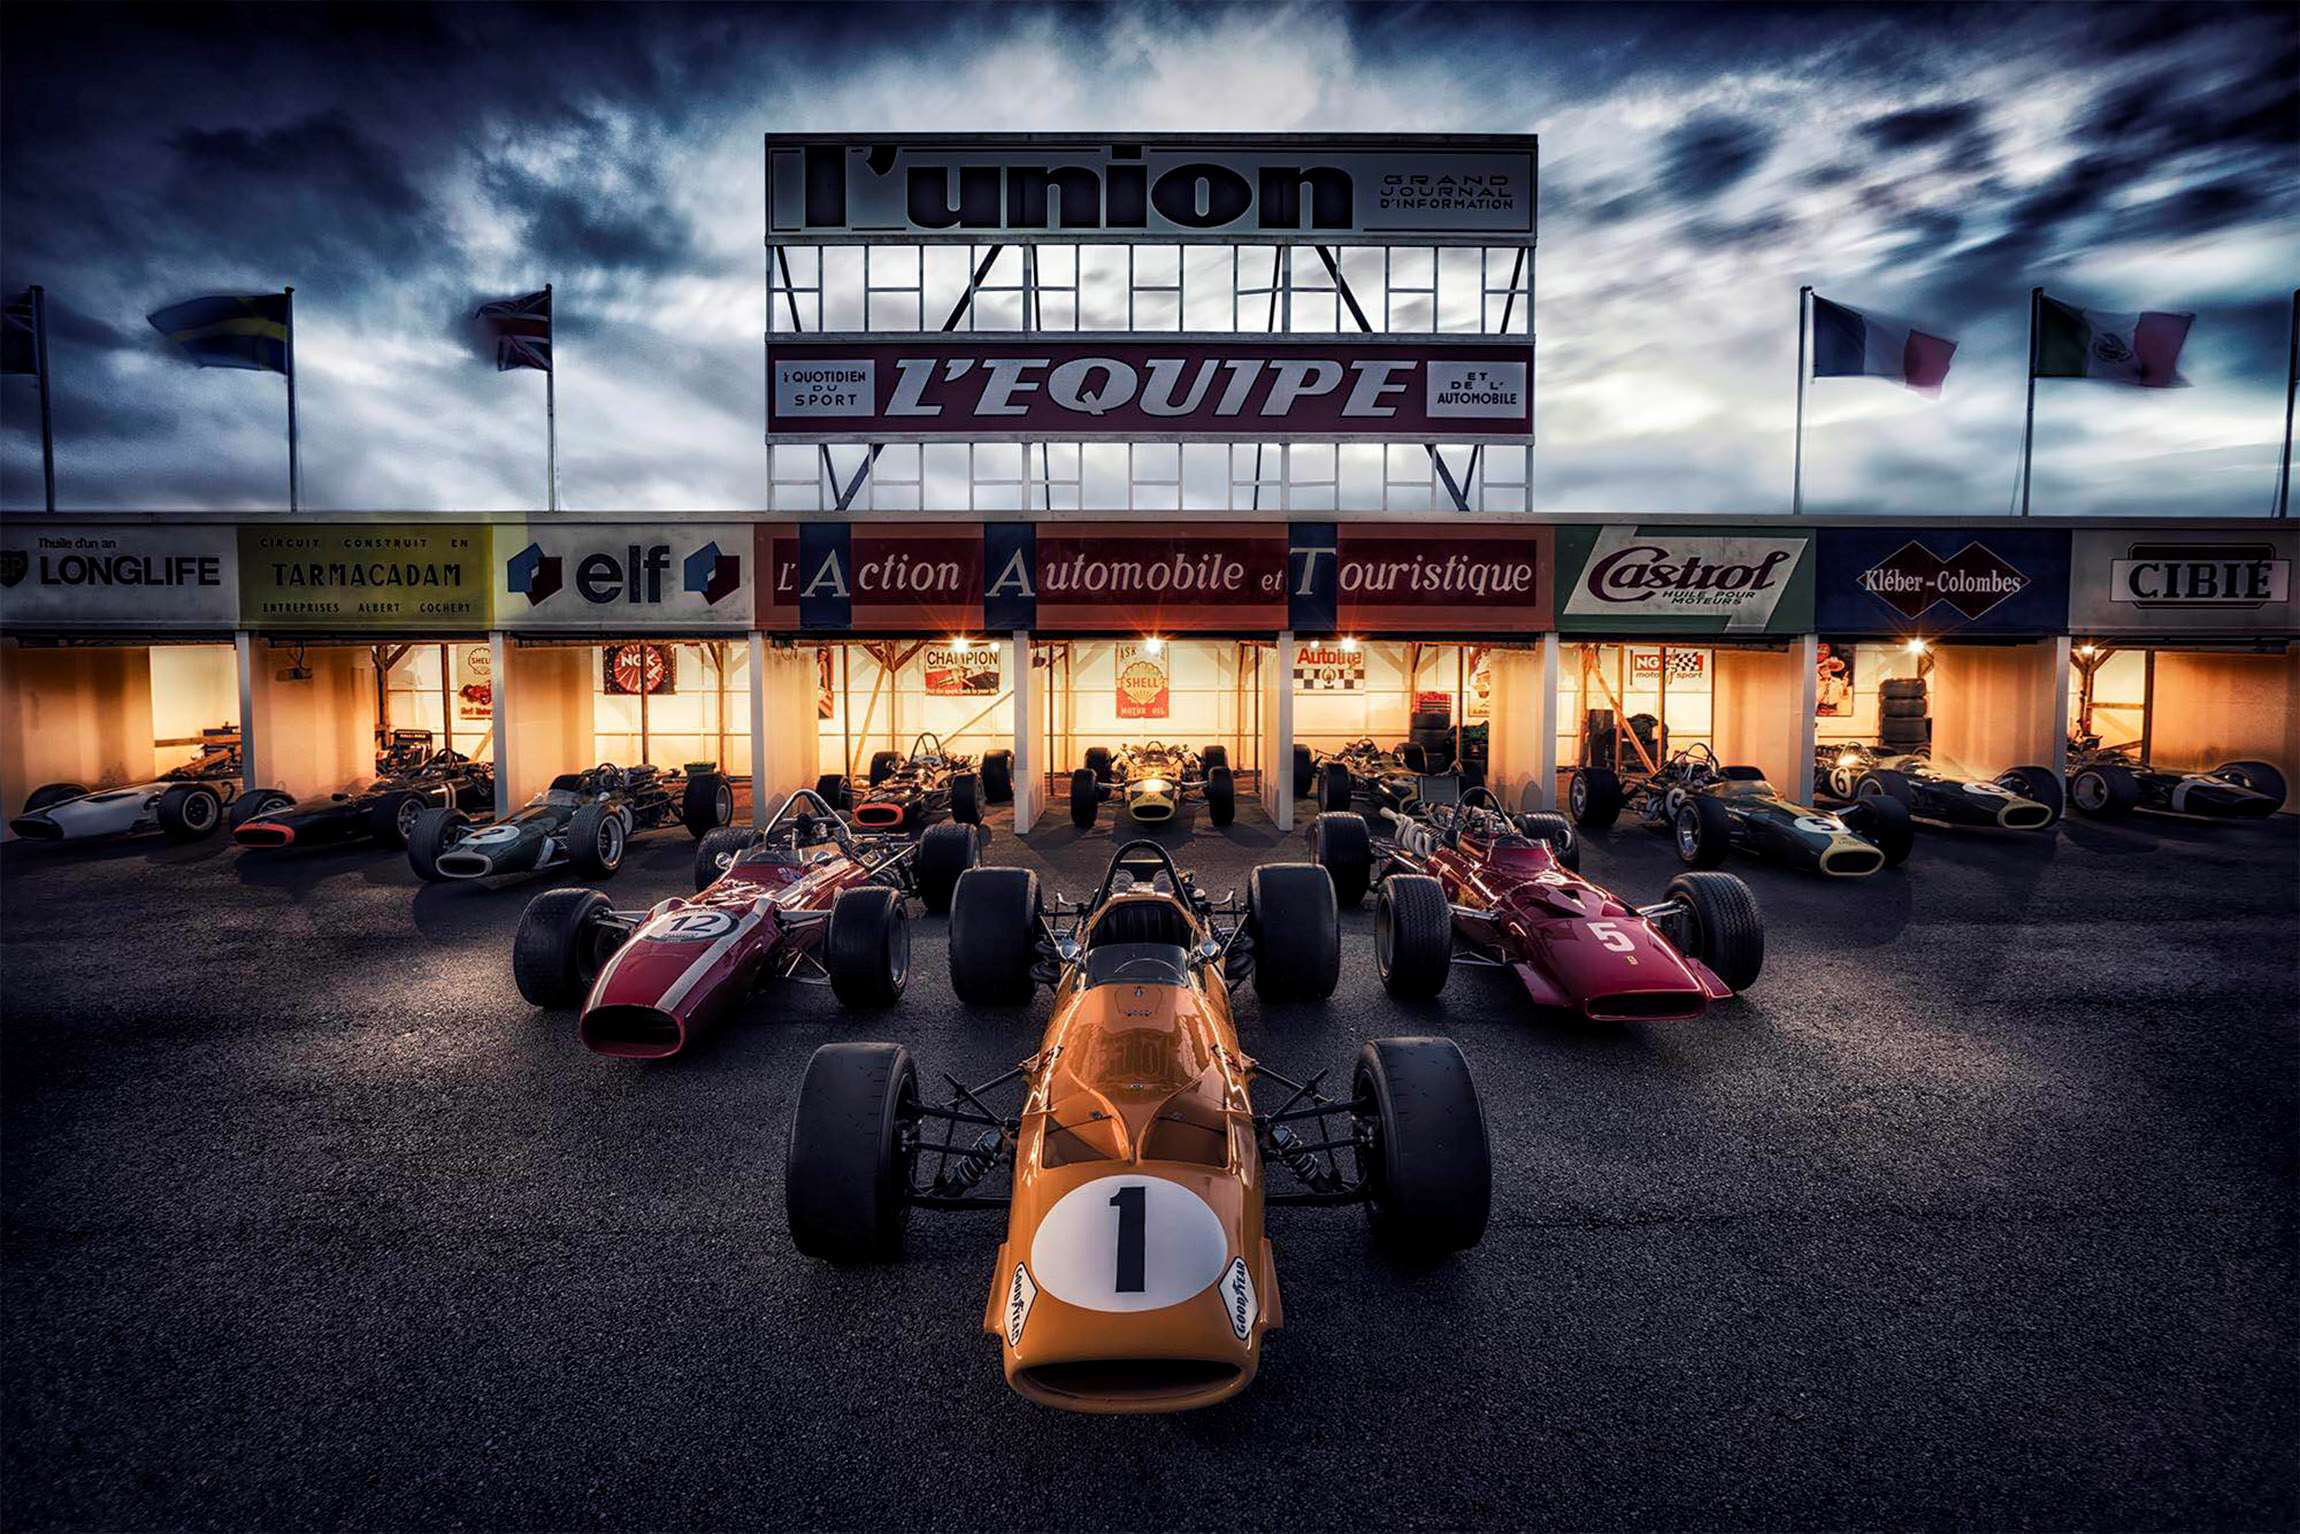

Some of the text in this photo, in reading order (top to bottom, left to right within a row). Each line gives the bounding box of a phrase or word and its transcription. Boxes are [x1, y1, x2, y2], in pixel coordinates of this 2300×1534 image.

[1383, 175, 1508, 186] GRAND
[1380, 186, 1512, 198] JOURNAL
[1380, 199, 1513, 210] D'INFORMATION
[792, 371, 866, 383] QUOTIDIEN
[1467, 372, 1488, 381] ET
[812, 384, 837, 392] DU
[883, 357, 1419, 418] L'EQUIPE
[1450, 381, 1473, 390] DE
[794, 394, 857, 406] SPORT
[1437, 392, 1517, 405] AUTOMOBILE
[103, 538, 117, 549] an
[259, 538, 469, 548] CIRCUIT CONSTRUIT EN
[39, 555, 221, 586] LONGLIFE
[271, 563, 461, 587] TARMACADAM
[575, 545, 670, 604] elf
[984, 548, 1245, 597] Automobile
[1261, 570, 1285, 591] et
[1289, 546, 1532, 597] Touristique
[1587, 546, 1791, 603] Castrol
[2128, 560, 2273, 599] CIBIÉ
[1661, 590, 1756, 599] HUILE POUR
[262, 603, 472, 614] ENTREPRISES ALBERT COCHERY
[471, 657, 490, 665] SHEL
[926, 651, 998, 665] CHAMPION
[1126, 677, 1159, 688] SHELL
[1835, 768, 1847, 794] 6
[669, 915, 722, 933] 12
[1587, 922, 1636, 952] 5
[1108, 1185, 1147, 1294] 1
[1235, 1260, 1248, 1334] GOODYEAR
